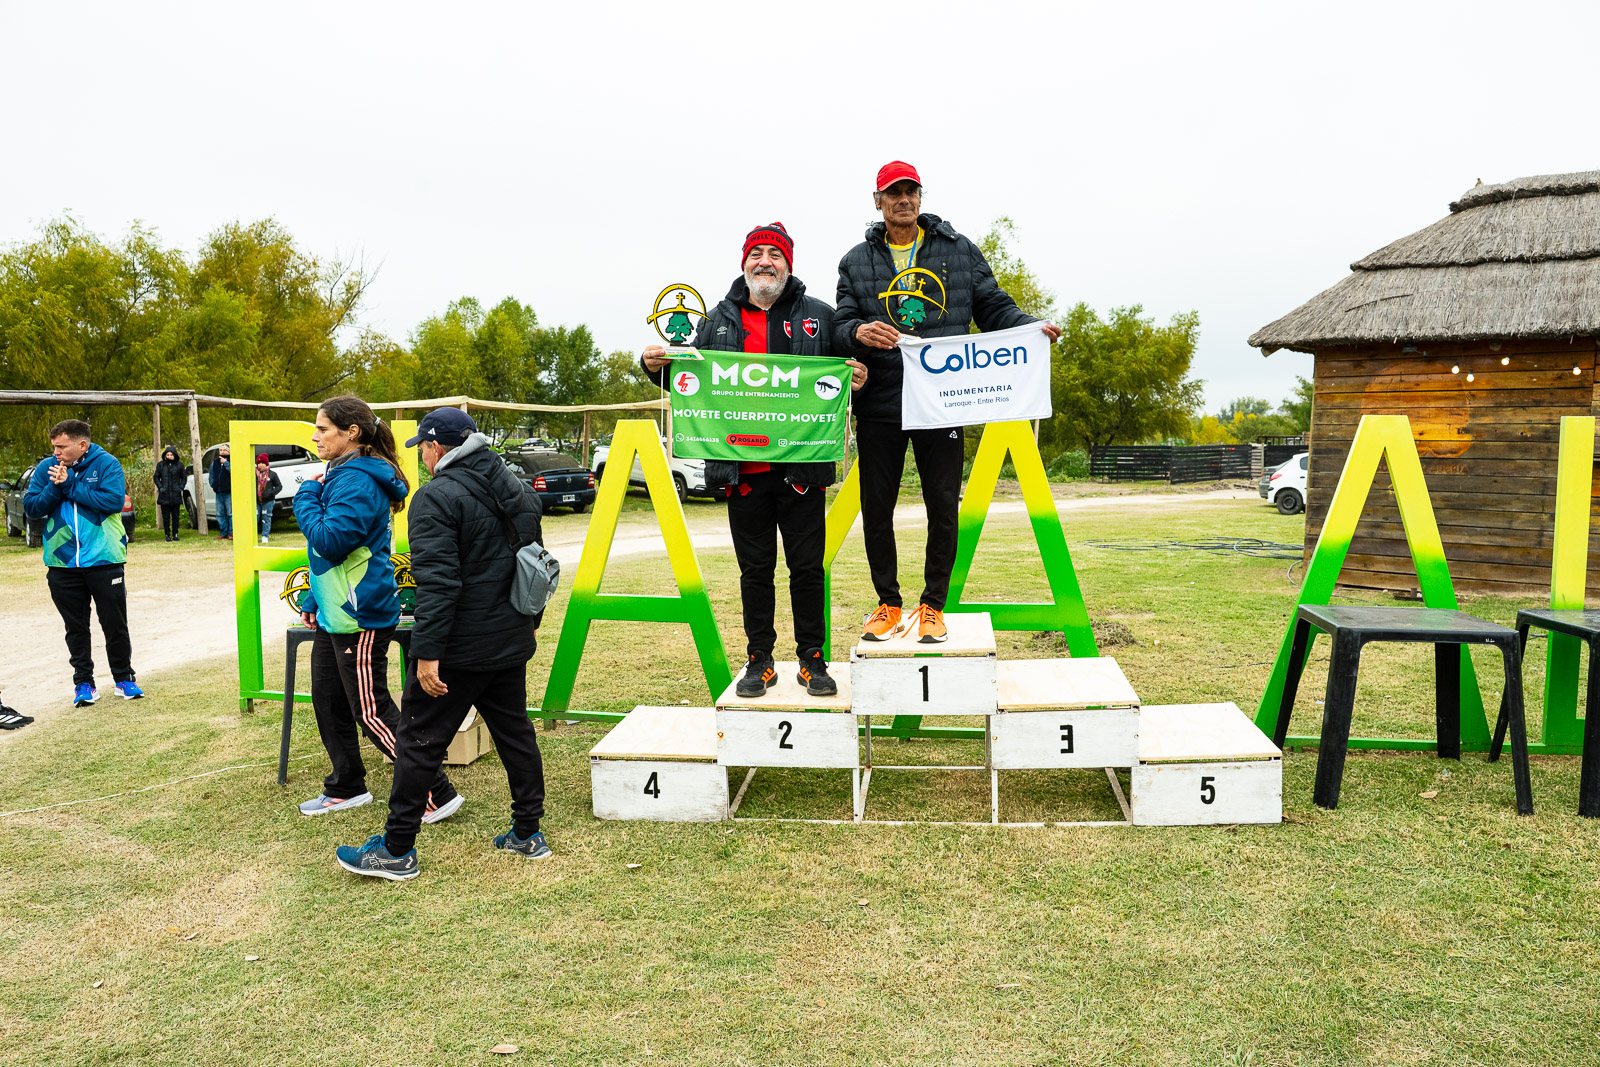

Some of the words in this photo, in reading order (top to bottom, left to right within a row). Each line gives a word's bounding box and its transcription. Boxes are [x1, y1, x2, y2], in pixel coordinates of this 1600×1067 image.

[919, 342, 1028, 374] Colben
[711, 360, 801, 388] MCM
[745, 391, 801, 399] ENTRENAMIENTO
[939, 384, 1013, 397] INDUMENTARIA
[944, 399, 972, 408] Larroque
[977, 397, 994, 405] Entre
[673, 408, 721, 420] MOVETE
[724, 411, 787, 422] CUERPITO
[790, 412, 837, 423] MOVETE
[737, 437, 768, 445] ROSARIO
[918, 665, 930, 702] 1
[778, 720, 794, 750] 2
[1060, 724, 1075, 755] 3
[643, 771, 661, 800] 4
[1199, 776, 1216, 806] 5
